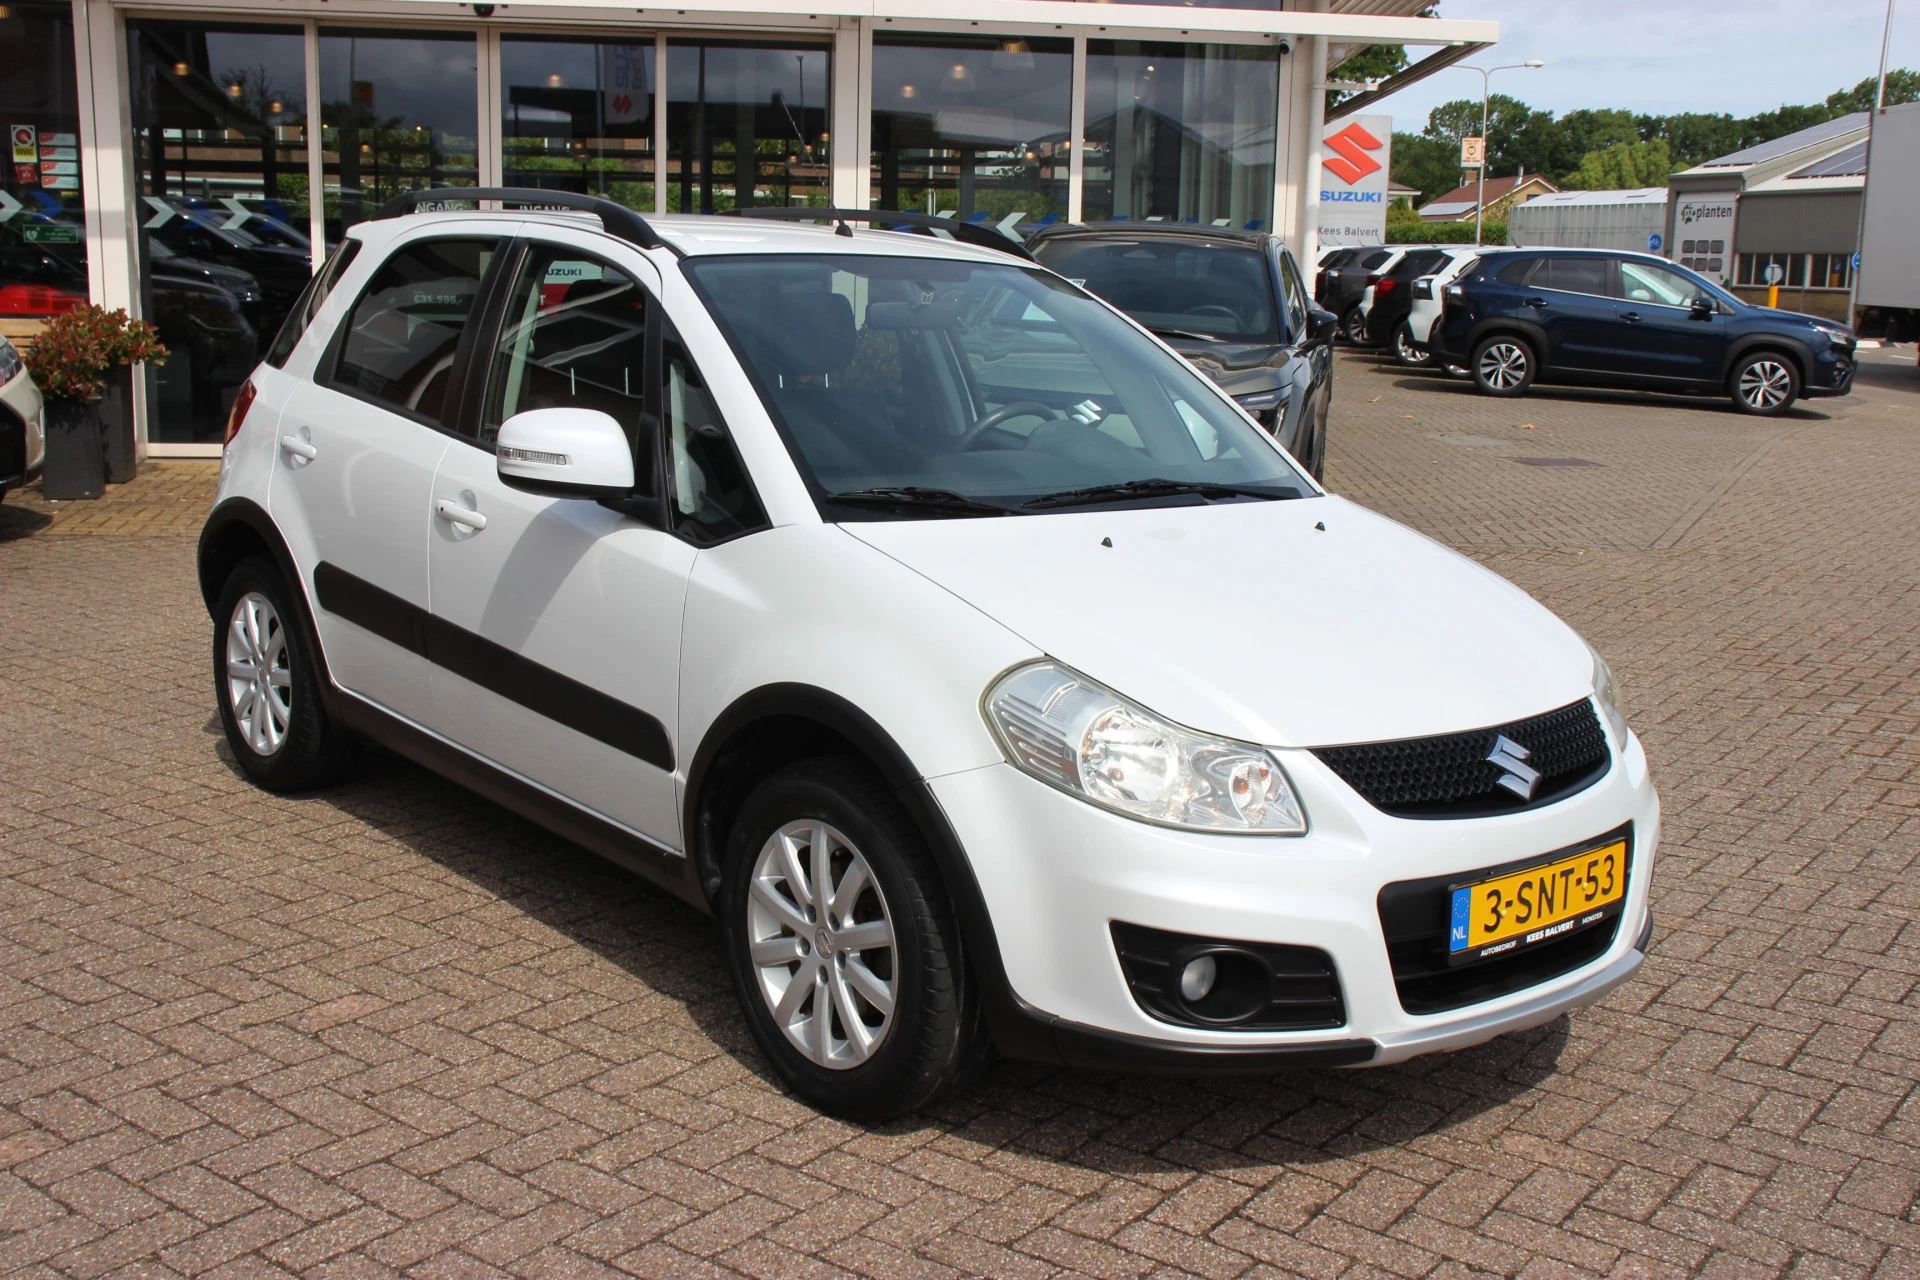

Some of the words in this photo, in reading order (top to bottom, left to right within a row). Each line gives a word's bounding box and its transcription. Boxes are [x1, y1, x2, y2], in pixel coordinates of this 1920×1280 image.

[1320, 190, 1382, 203] SUZUKI
[415, 202, 464, 212] NGANG
[1696, 204, 1732, 222] planten
[1318, 226, 1341, 236] Kees
[1344, 226, 1379, 237] Balvert
[547, 268, 582, 276] UZUKI
[1484, 854, 1615, 933] 3-SNT-53
[1452, 925, 1467, 941] NL
[1526, 930, 1544, 943] KEES
[1545, 920, 1574, 938] BALVERT
[1582, 911, 1603, 924] MONSTER
